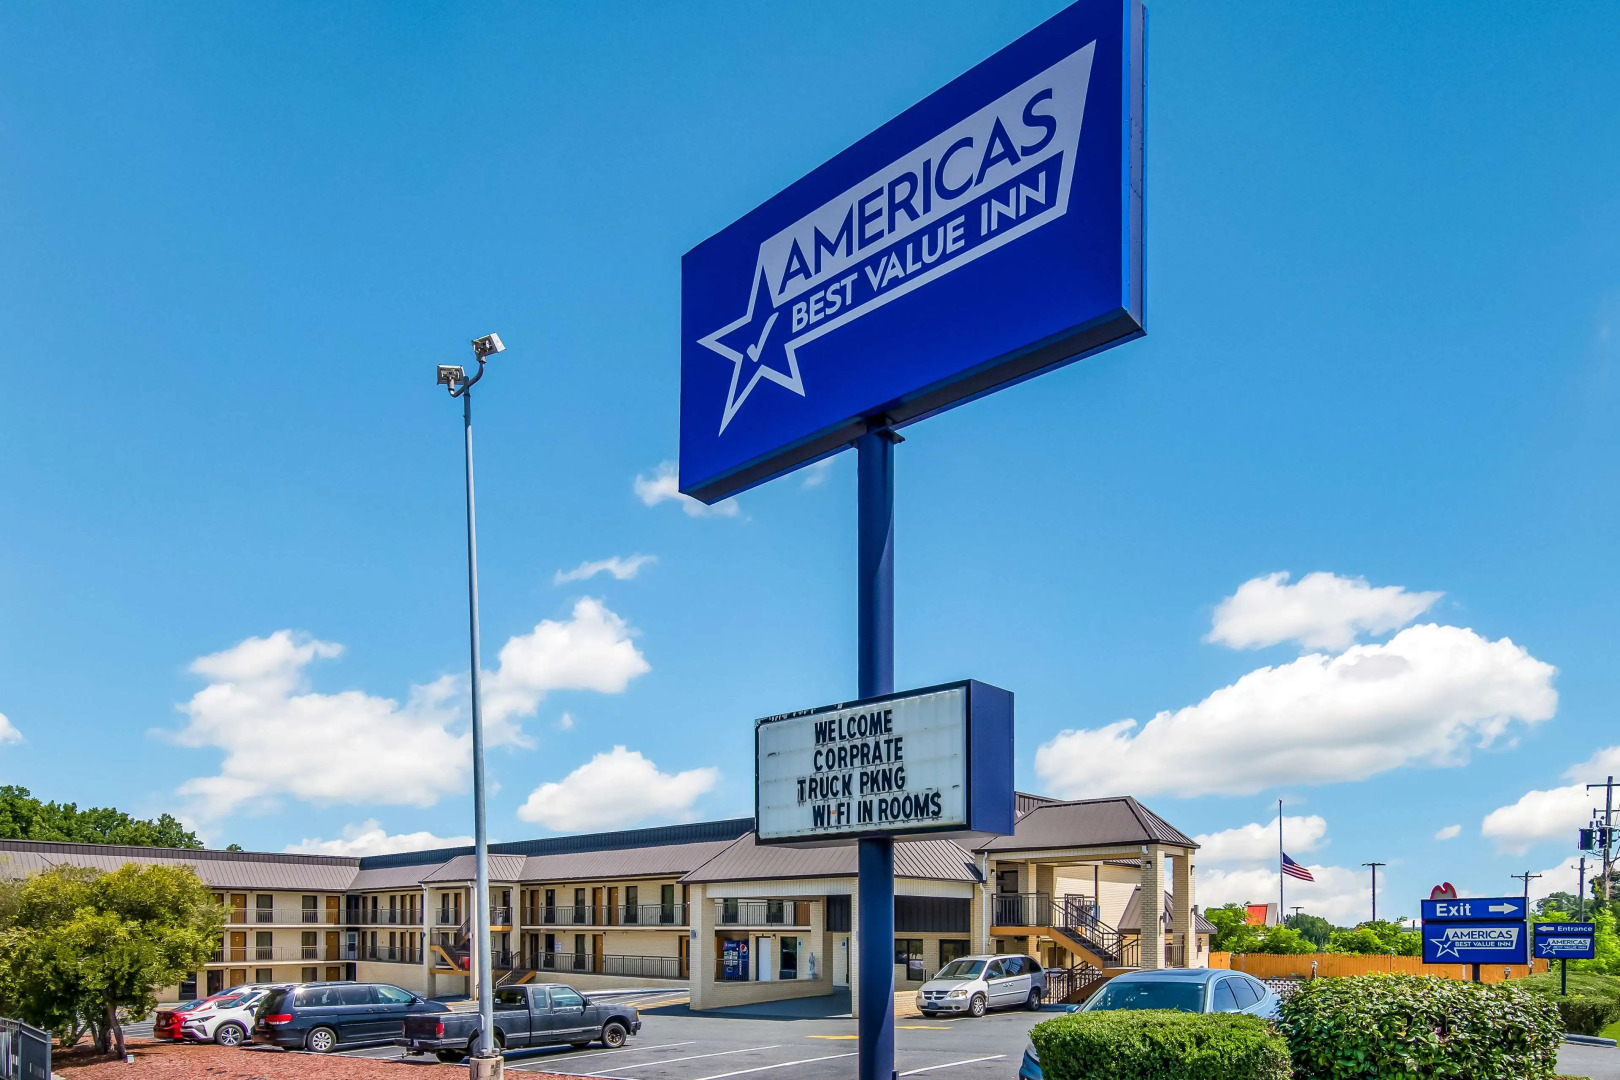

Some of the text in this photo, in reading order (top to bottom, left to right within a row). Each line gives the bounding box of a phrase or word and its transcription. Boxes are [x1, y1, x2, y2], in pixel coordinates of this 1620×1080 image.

[778, 87, 1057, 296] AMERICAS
[791, 170, 1046, 333] BEST VALUE INN
[814, 709, 892, 743] WELCOME
[813, 737, 903, 771] CORPRATE
[797, 766, 906, 801] TRUCK PKNG
[857, 799, 873, 823] IN
[878, 791, 942, 821] ROOMS
[1436, 902, 1472, 917] Exit
[1451, 930, 1513, 940] AMERICAS
